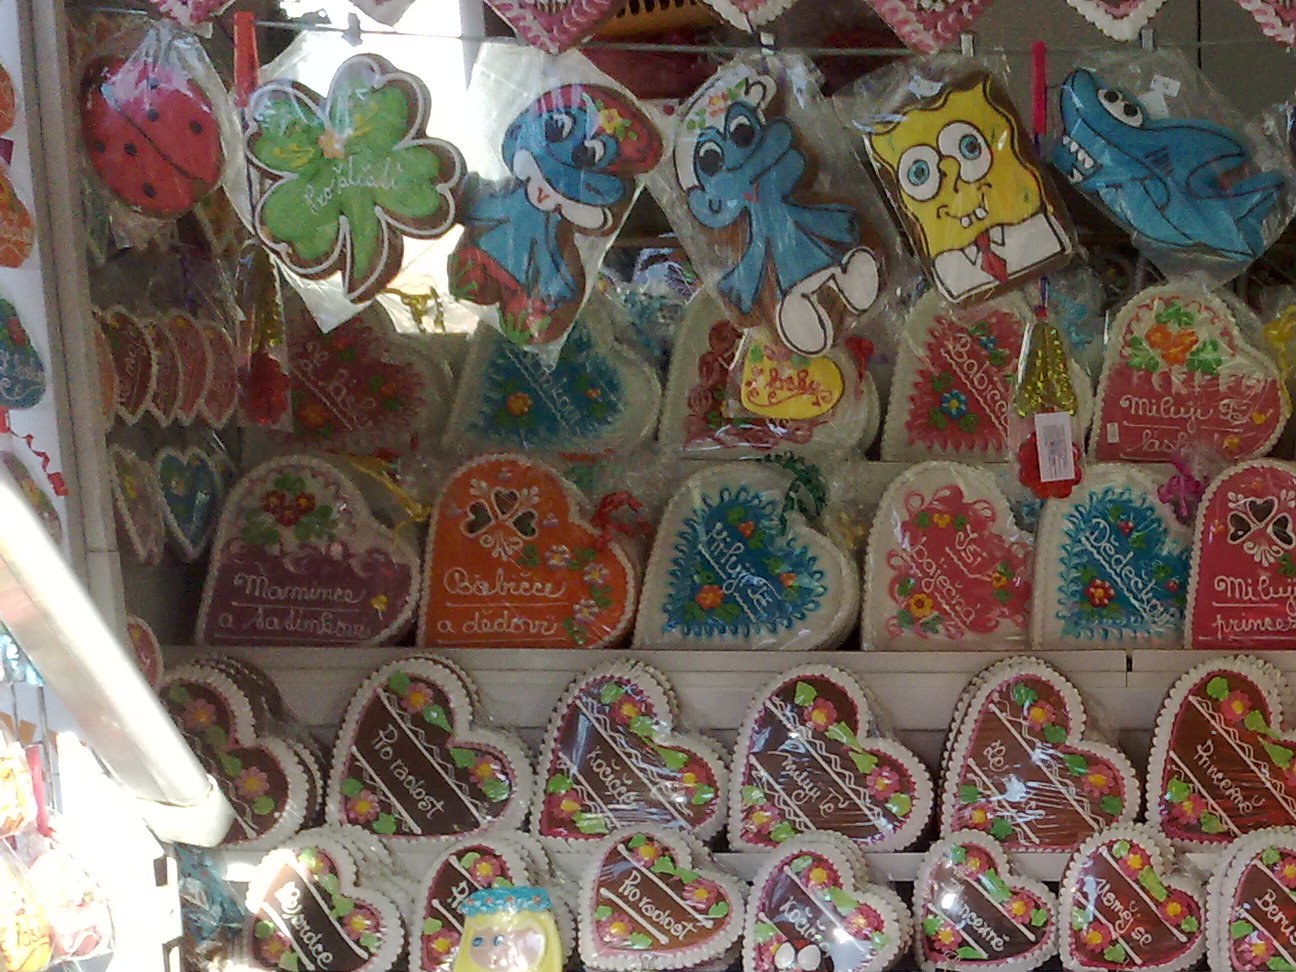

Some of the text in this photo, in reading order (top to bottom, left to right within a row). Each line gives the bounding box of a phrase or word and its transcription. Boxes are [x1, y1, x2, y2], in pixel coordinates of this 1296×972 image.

[1120, 394, 1251, 429] Miluji Tě
[232, 573, 366, 604] Mamince
[443, 568, 567, 599] Babičce
[438, 617, 455, 633] a
[370, 723, 445, 820] Pro radost
[619, 869, 698, 940] Pro radost
[1131, 923, 1153, 946] se
